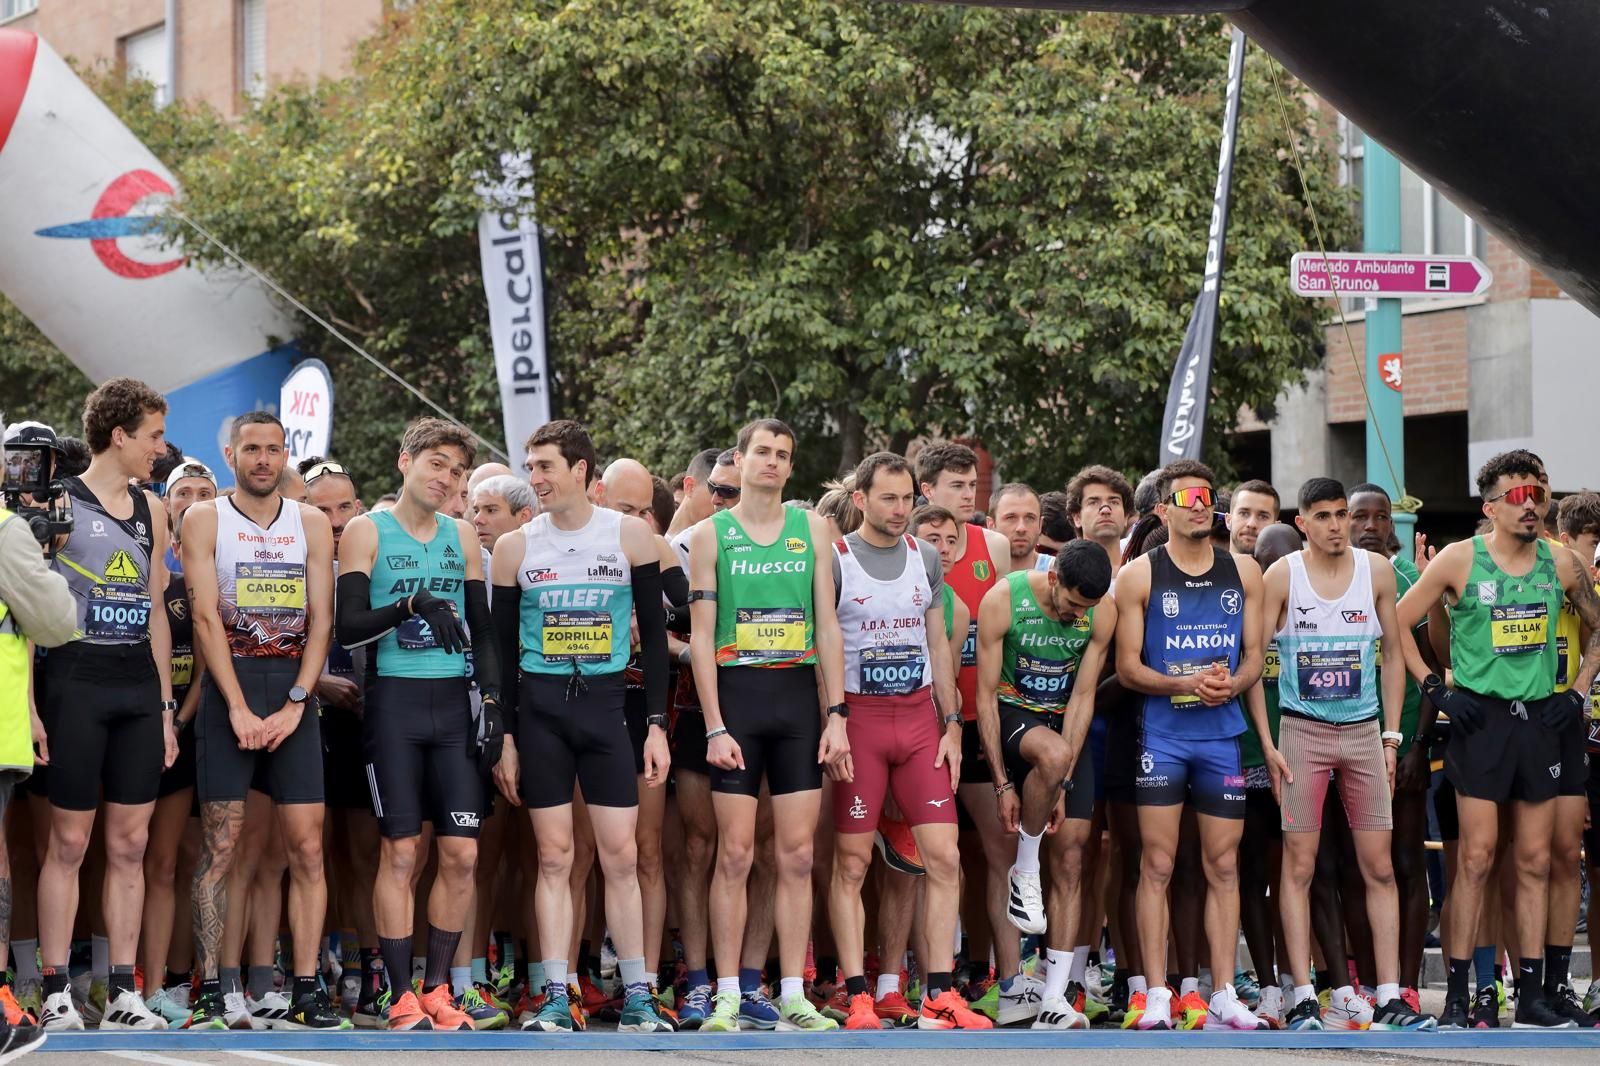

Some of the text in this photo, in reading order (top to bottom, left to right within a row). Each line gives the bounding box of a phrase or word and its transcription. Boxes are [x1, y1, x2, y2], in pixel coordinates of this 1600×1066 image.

[1300, 259, 1415, 275] Mercado Ambulante
[1299, 276, 1373, 291] San Bruno
[587, 566, 623, 578] LaMafia
[730, 559, 807, 576] Huesca
[246, 583, 297, 594] CARLOS
[389, 577, 462, 594] ATLEET
[539, 588, 614, 609] ATLEET
[92, 605, 147, 625] 10003
[860, 617, 921, 632] A.D.A. ZUERA
[1176, 623, 1193, 631] CLUB
[1502, 623, 1541, 634] SELLAK
[546, 631, 609, 641] ZORRILLA
[757, 628, 785, 637] LUIS
[566, 643, 590, 651] 4946
[768, 639, 774, 647] 7
[1020, 632, 1087, 649] Huesca
[1165, 631, 1236, 650] NARÓN
[863, 665, 921, 682] 10004
[1308, 671, 1350, 688] 4911
